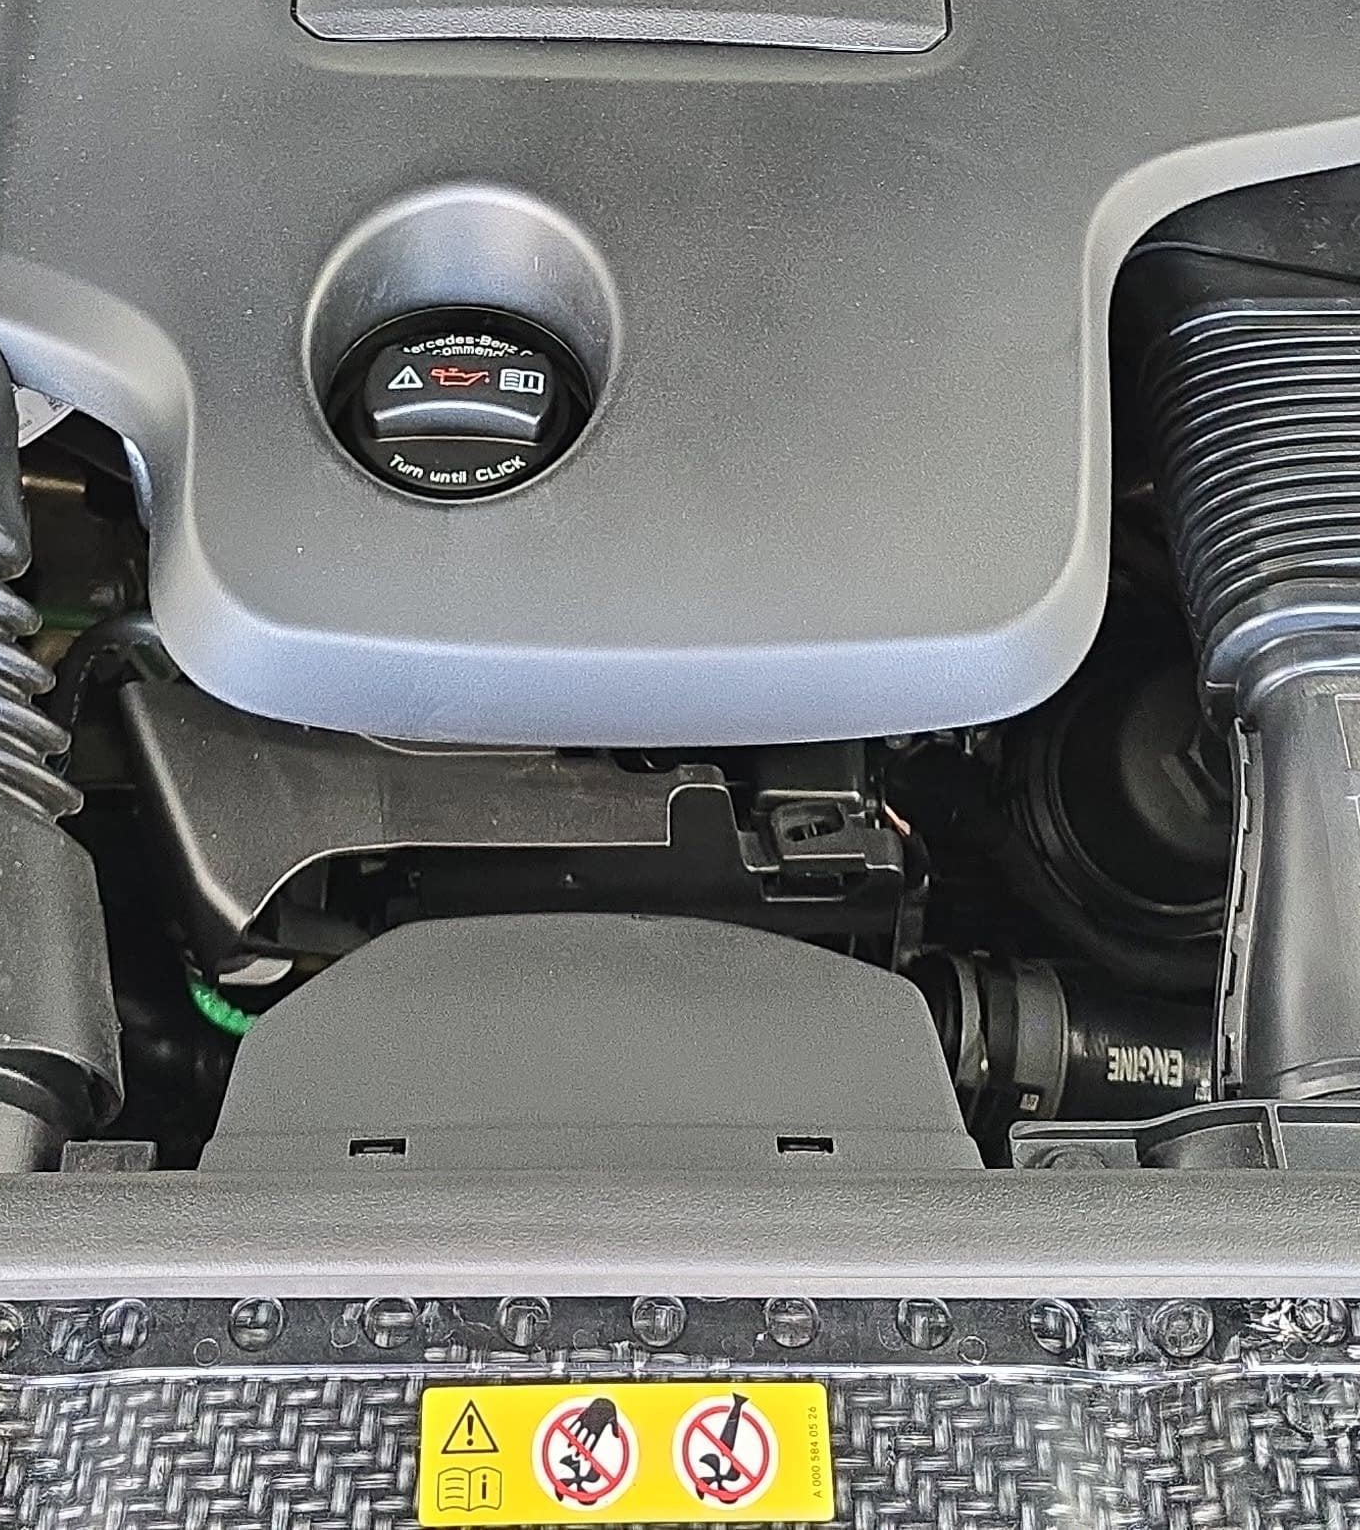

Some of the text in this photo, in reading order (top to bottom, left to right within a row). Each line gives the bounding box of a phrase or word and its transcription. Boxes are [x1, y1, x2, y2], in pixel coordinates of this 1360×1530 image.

[390, 454, 526, 483] Turn until CLICK
[1107, 1045, 1183, 1088] ENGINE
[807, 1406, 823, 1499] A 000 584 05 26
